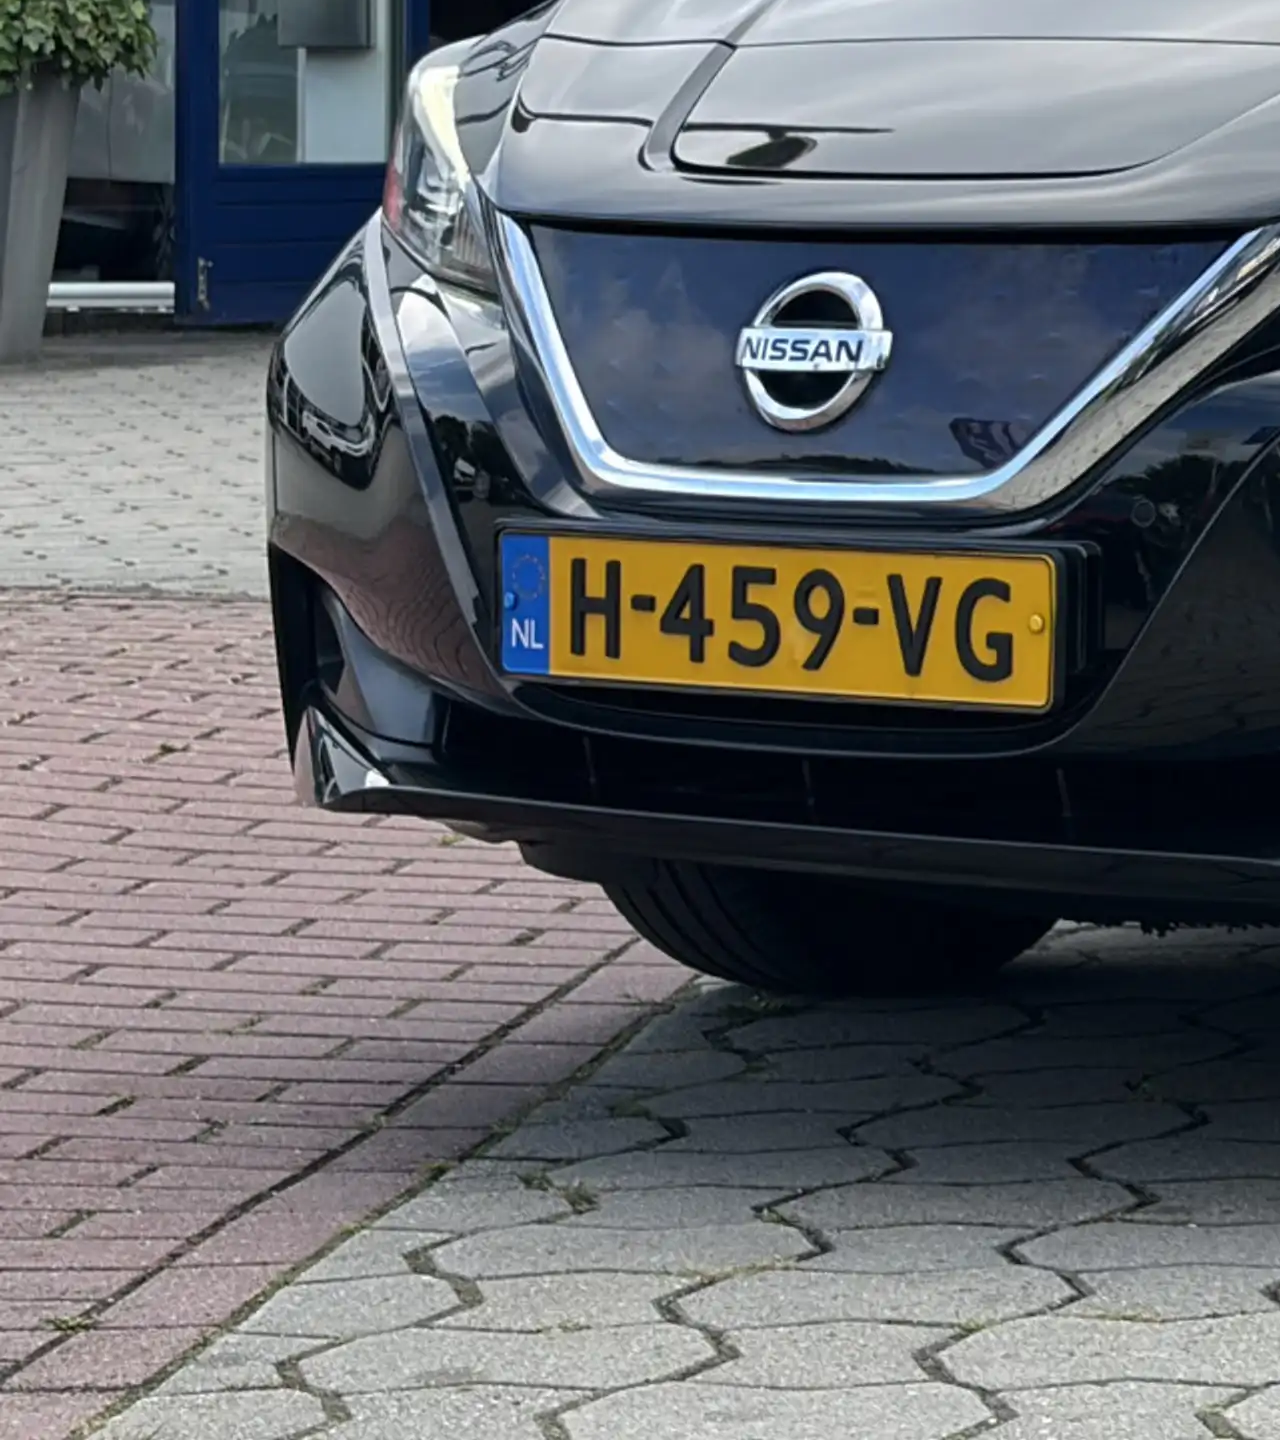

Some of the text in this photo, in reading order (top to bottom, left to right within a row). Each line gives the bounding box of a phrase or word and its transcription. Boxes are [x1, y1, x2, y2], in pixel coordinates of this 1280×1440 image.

[743, 337, 864, 362] NISSAN
[510, 617, 544, 650] NL
[570, 557, 1014, 683] H-459-VG
